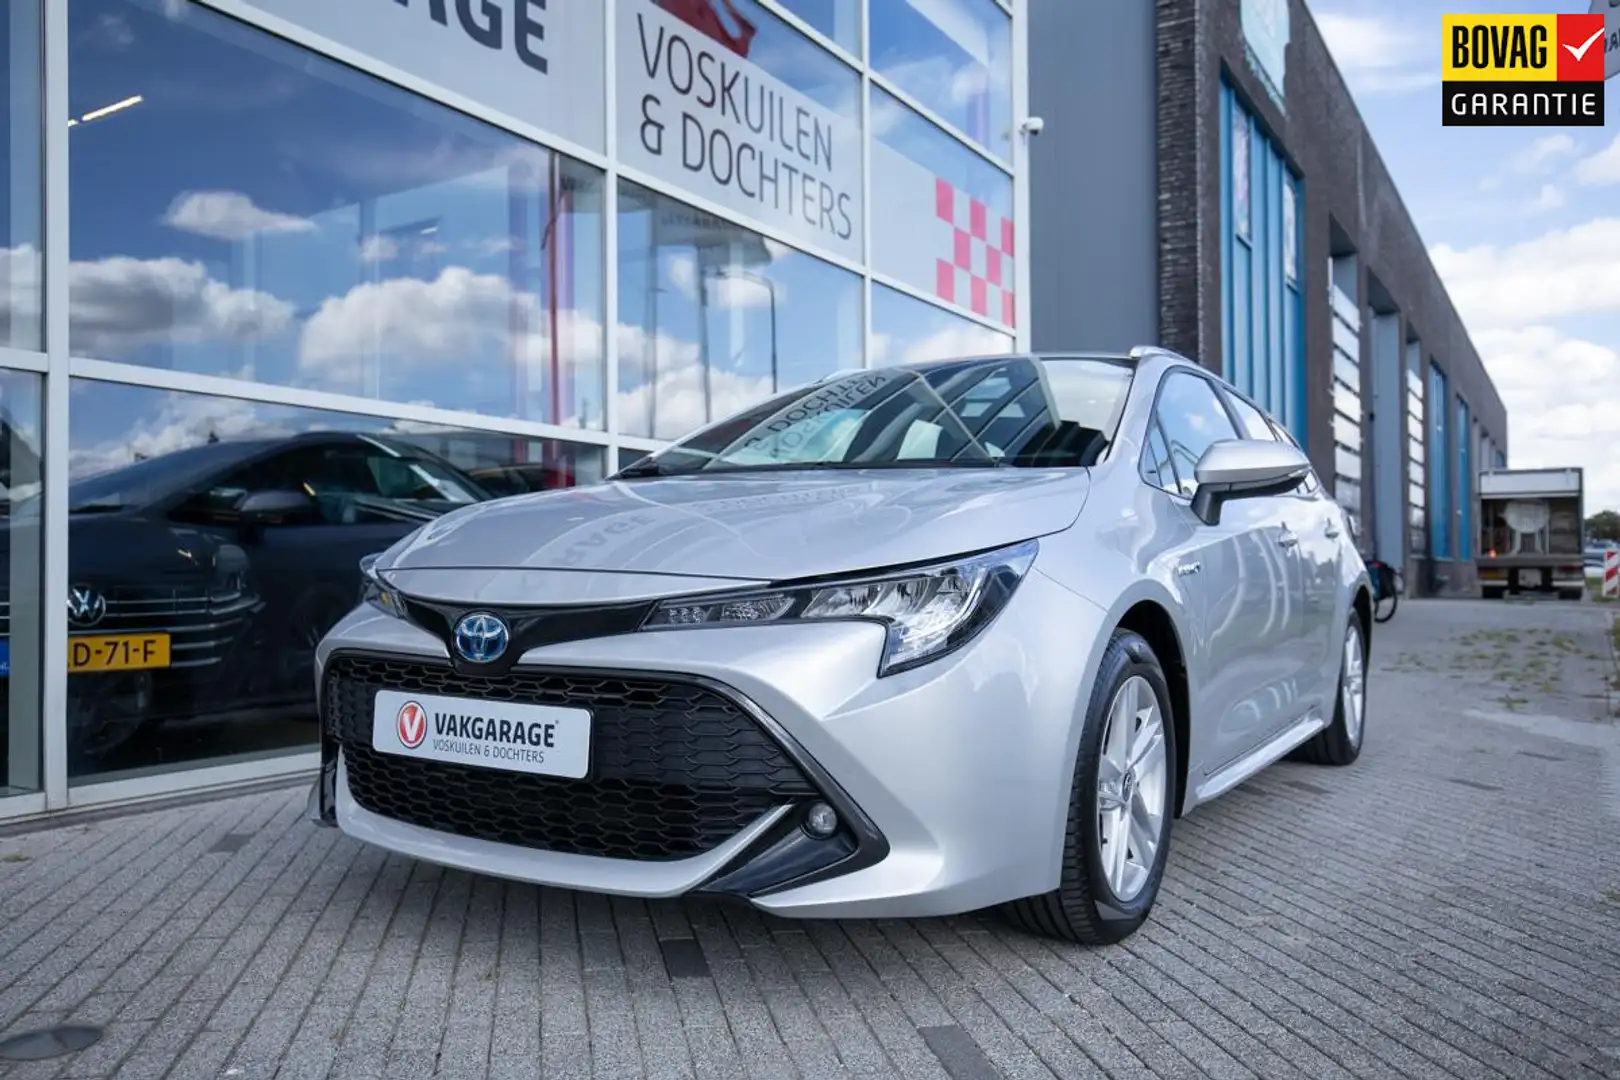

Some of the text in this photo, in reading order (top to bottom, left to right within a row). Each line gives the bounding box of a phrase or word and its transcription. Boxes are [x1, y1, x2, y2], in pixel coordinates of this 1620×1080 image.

[637, 13, 832, 172] VOSKUILEN
[640, 94, 852, 240] & DOCHTERS
[432, 739, 545, 764] VOSKUILEN & DOCHTERS
[435, 712, 555, 748] VAKGARAGE
